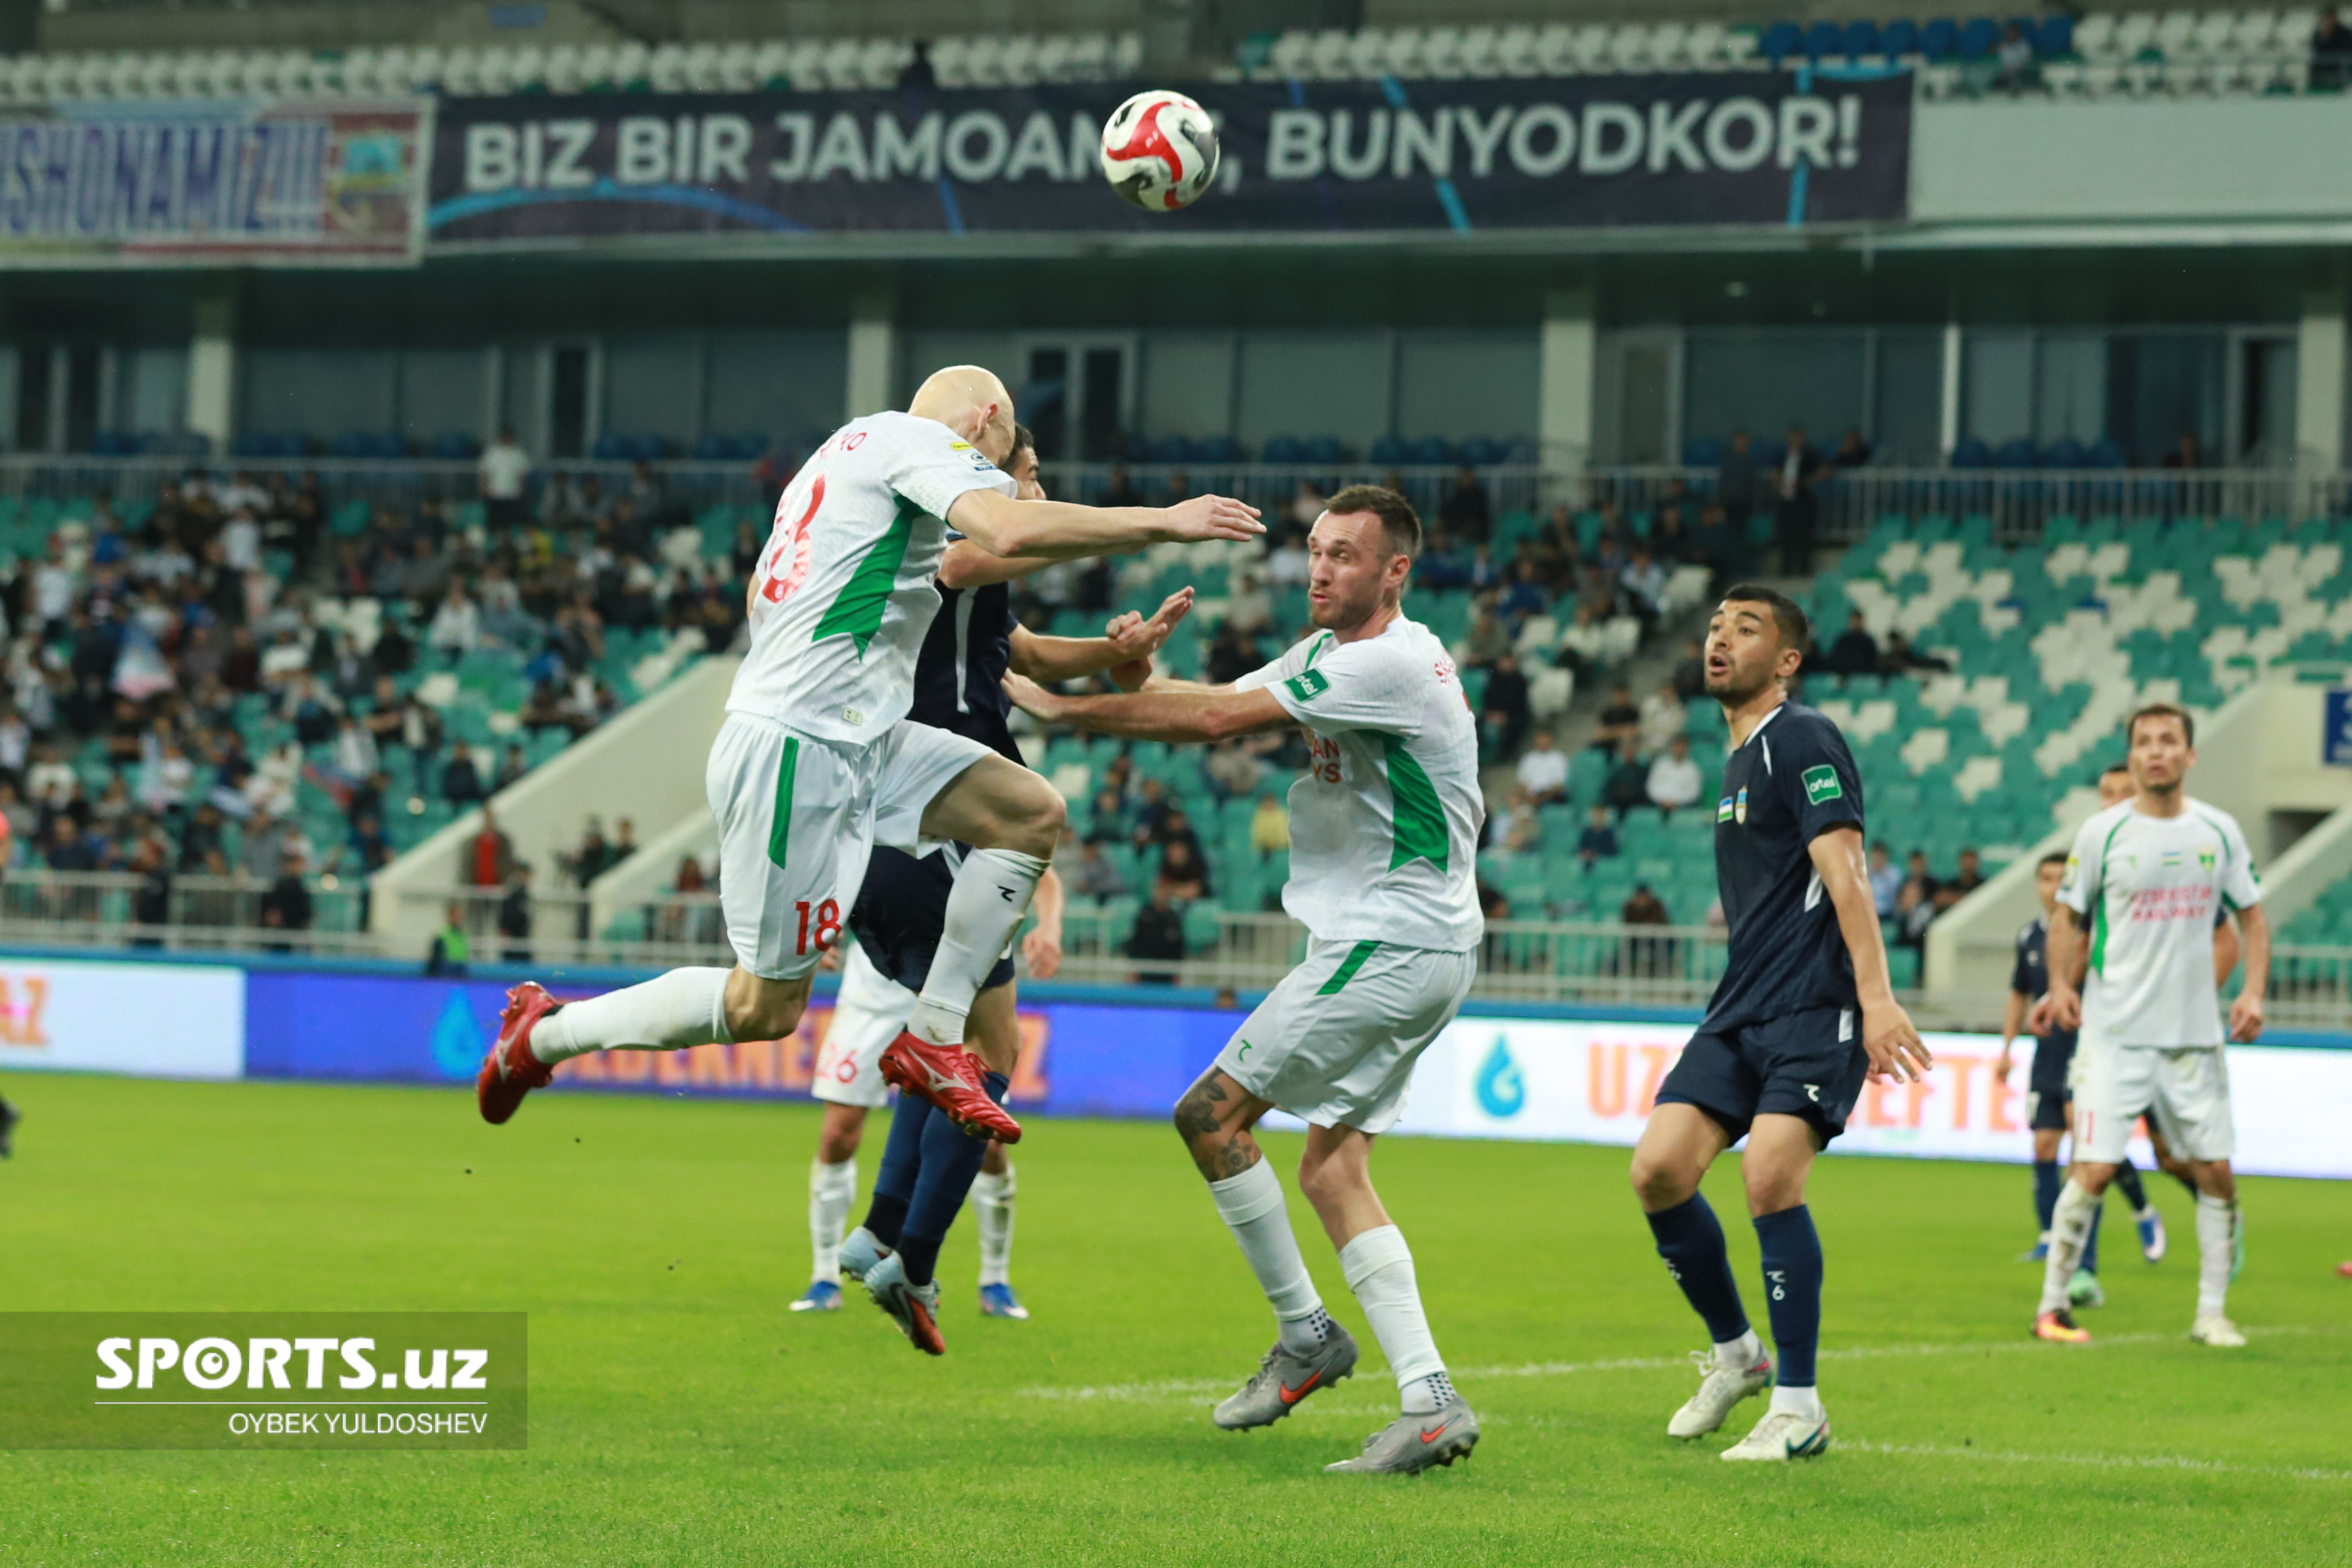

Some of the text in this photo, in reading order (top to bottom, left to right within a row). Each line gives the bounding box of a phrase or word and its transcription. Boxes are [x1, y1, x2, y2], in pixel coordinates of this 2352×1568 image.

[465, 121, 596, 189] BIZ
[617, 116, 752, 184] BIR
[1266, 96, 1860, 178] BUNYODKOR!
[795, 899, 841, 955] 18
[1772, 1284, 1785, 1301] 6
